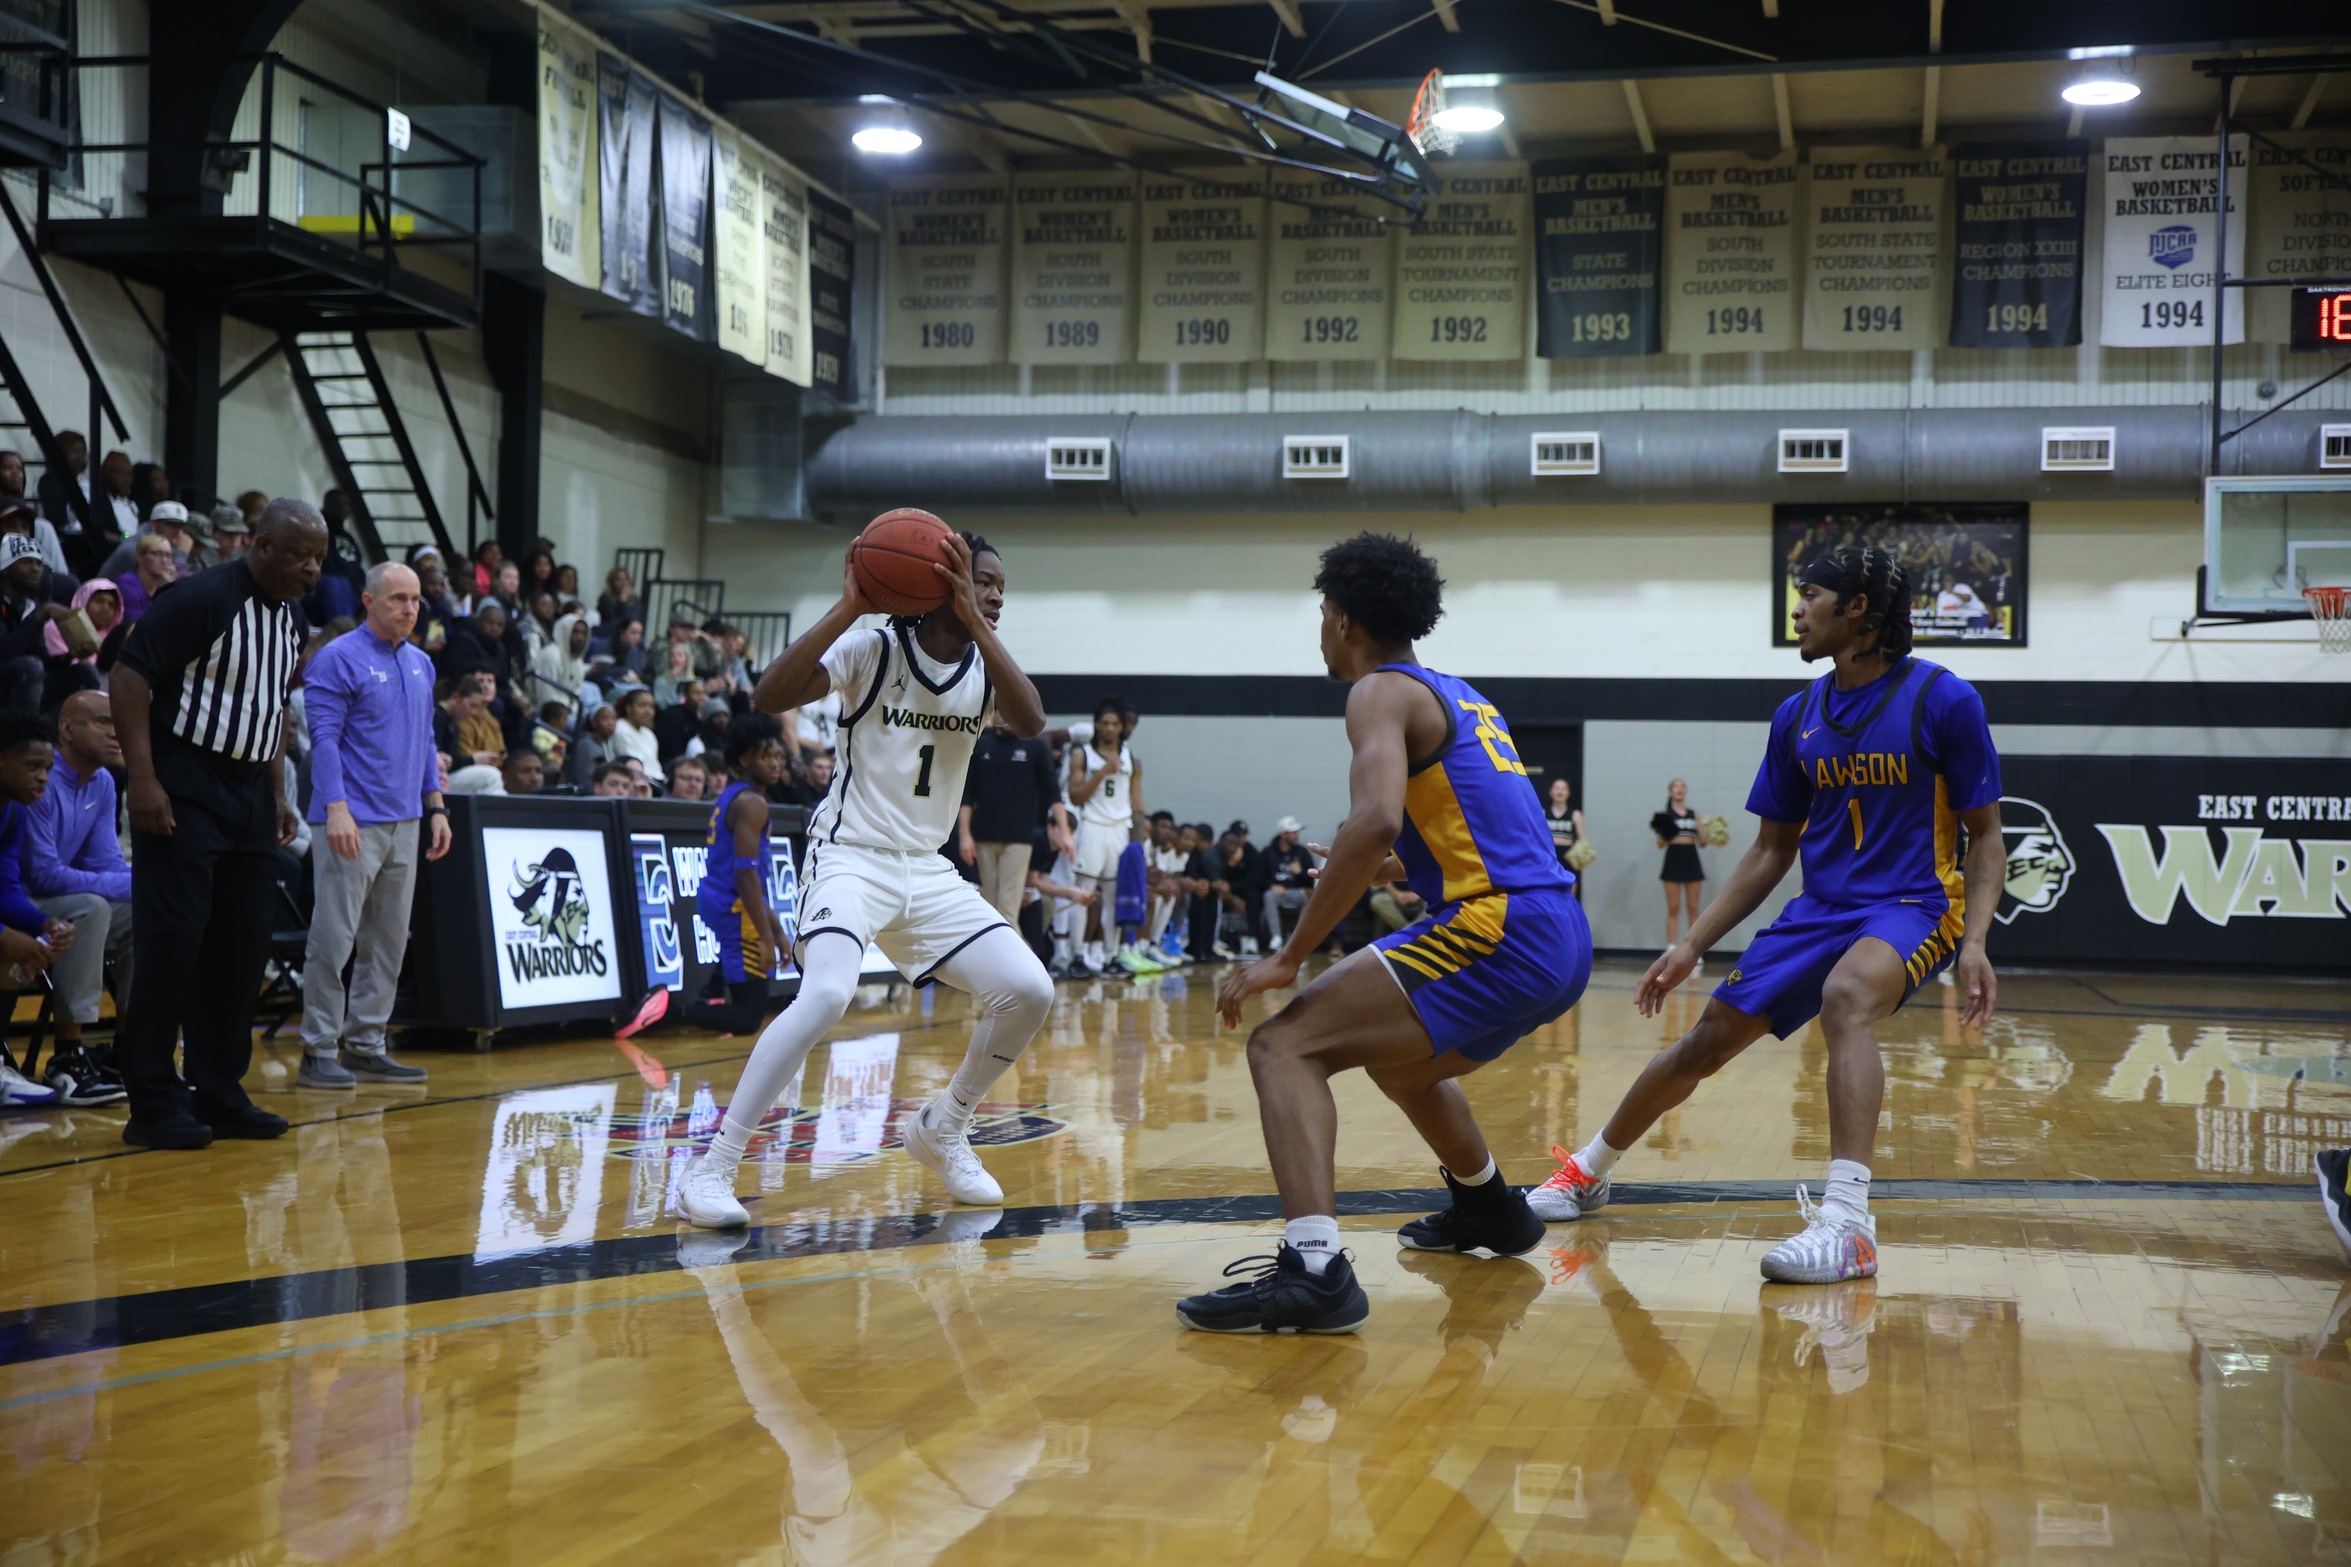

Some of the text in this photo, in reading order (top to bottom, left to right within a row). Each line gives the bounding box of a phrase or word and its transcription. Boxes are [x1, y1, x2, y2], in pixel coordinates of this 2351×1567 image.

[1813, 160, 1944, 181] EAST CENTRAL
[1959, 156, 2086, 177] EAST CENTRAL
[2108, 156, 2153, 172] EAST
[1536, 170, 1664, 193] EAST CENTRAL
[1673, 165, 1797, 186] EAST CENTRAL
[1062, 186, 1136, 203] CENTRAL
[1145, 185, 1184, 201] EAST
[1451, 178, 1526, 195] CENTRAL
[1980, 182, 2061, 202] WOMEN'S
[2132, 179, 2218, 197] WOMEN'S
[1710, 193, 1761, 212] MEN'S
[1850, 188, 1905, 205] MEN'S
[1167, 208, 1243, 224] WOMEN'S
[1437, 202, 1490, 219] MEN'S
[1572, 197, 1627, 217] MEN'S
[1820, 205, 1933, 224] BASKETBALL
[1963, 201, 2077, 222] BASKETBALL
[1409, 219, 1518, 237] BASKETBALL
[1544, 213, 1656, 236] BASKETBALL
[1681, 209, 1790, 229] BASKETBALL
[898, 229, 999, 246] BASKETBALL
[1024, 228, 1126, 245] BASKETBALL
[1153, 225, 1257, 243] BASKETBALL
[1281, 222, 1387, 240] BASKETBALL
[1707, 236, 1764, 252] SOUTH
[1815, 232, 1936, 249] SOUTH STATE
[2148, 232, 2198, 257] NJCAA
[1175, 250, 1232, 266] SOUTH
[1304, 248, 1361, 263] SOUTH
[1405, 245, 1519, 261] SOUTH STATE
[1960, 240, 2078, 260] REGION XXIII
[920, 254, 976, 269] SOUTH
[1046, 253, 1102, 268] SOUTH
[1572, 253, 1628, 271] STATE
[1697, 258, 1775, 275] DIVISION
[1811, 254, 1938, 271] TOURNAMENT
[1036, 273, 1112, 289] DIVISION
[1166, 271, 1243, 287] DIVISION
[1295, 268, 1370, 284] DIVISION
[1401, 267, 1521, 282] TOURNAMENT
[1962, 262, 2075, 282] CHAMPIONS
[922, 274, 973, 290] STATE
[1546, 273, 1655, 293] CHAMPIONS
[1682, 278, 1790, 296] CHAMPIONS
[1818, 276, 1931, 293] CHAMPIONS
[2116, 274, 2167, 290] ELITE
[899, 294, 998, 311] CHAMPIONS
[1024, 293, 1124, 309] CHAMPIONS
[1153, 291, 1253, 307] CHAMPIONS
[1281, 289, 1383, 305] CHAMPIONS
[1408, 287, 1513, 303] CHAMPIONS
[1706, 307, 1764, 335] 1994
[1842, 305, 1903, 333] 1994
[1987, 303, 2048, 332] 1994
[2141, 300, 2204, 329] 1994
[920, 322, 975, 349] 1980
[1045, 321, 1100, 348] 1989
[1176, 319, 1230, 346] 1990
[1303, 317, 1359, 343] 1992
[1430, 316, 1488, 343] 1992
[1572, 312, 1631, 343] 1993
[1457, 699, 1527, 776] 25
[913, 744, 936, 797] 1
[1105, 780, 1114, 797] 6
[2198, 795, 2257, 820] EAST
[1848, 798, 1864, 851] 1
[2007, 856, 2045, 882] EC
[505, 939, 608, 984] WARRIORS
[1296, 1240, 1328, 1248] PUMA
